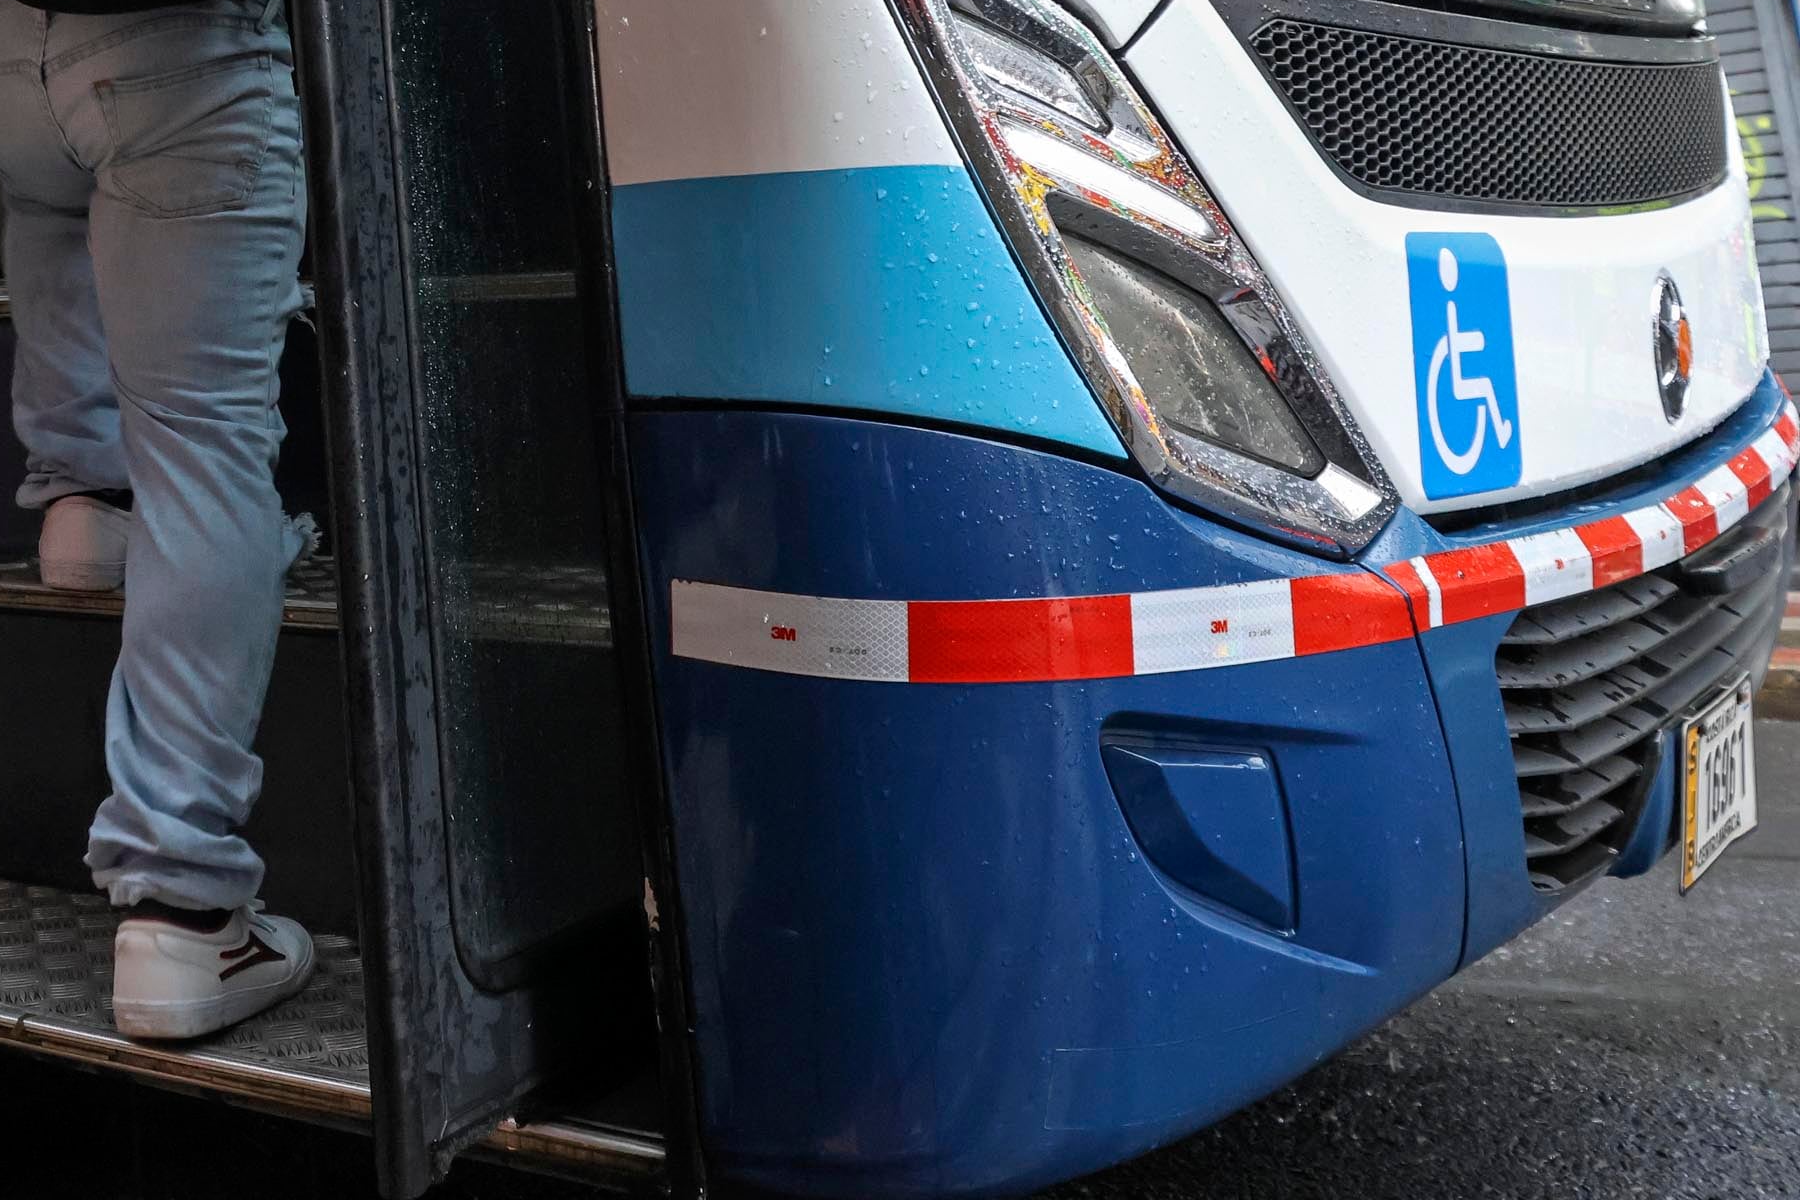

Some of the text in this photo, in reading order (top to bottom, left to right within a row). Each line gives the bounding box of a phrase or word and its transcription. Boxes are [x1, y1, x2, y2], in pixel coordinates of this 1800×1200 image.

[771, 626, 797, 642] 3M
[1210, 619, 1228, 634] 3M
[1704, 720, 1747, 834] 16961
